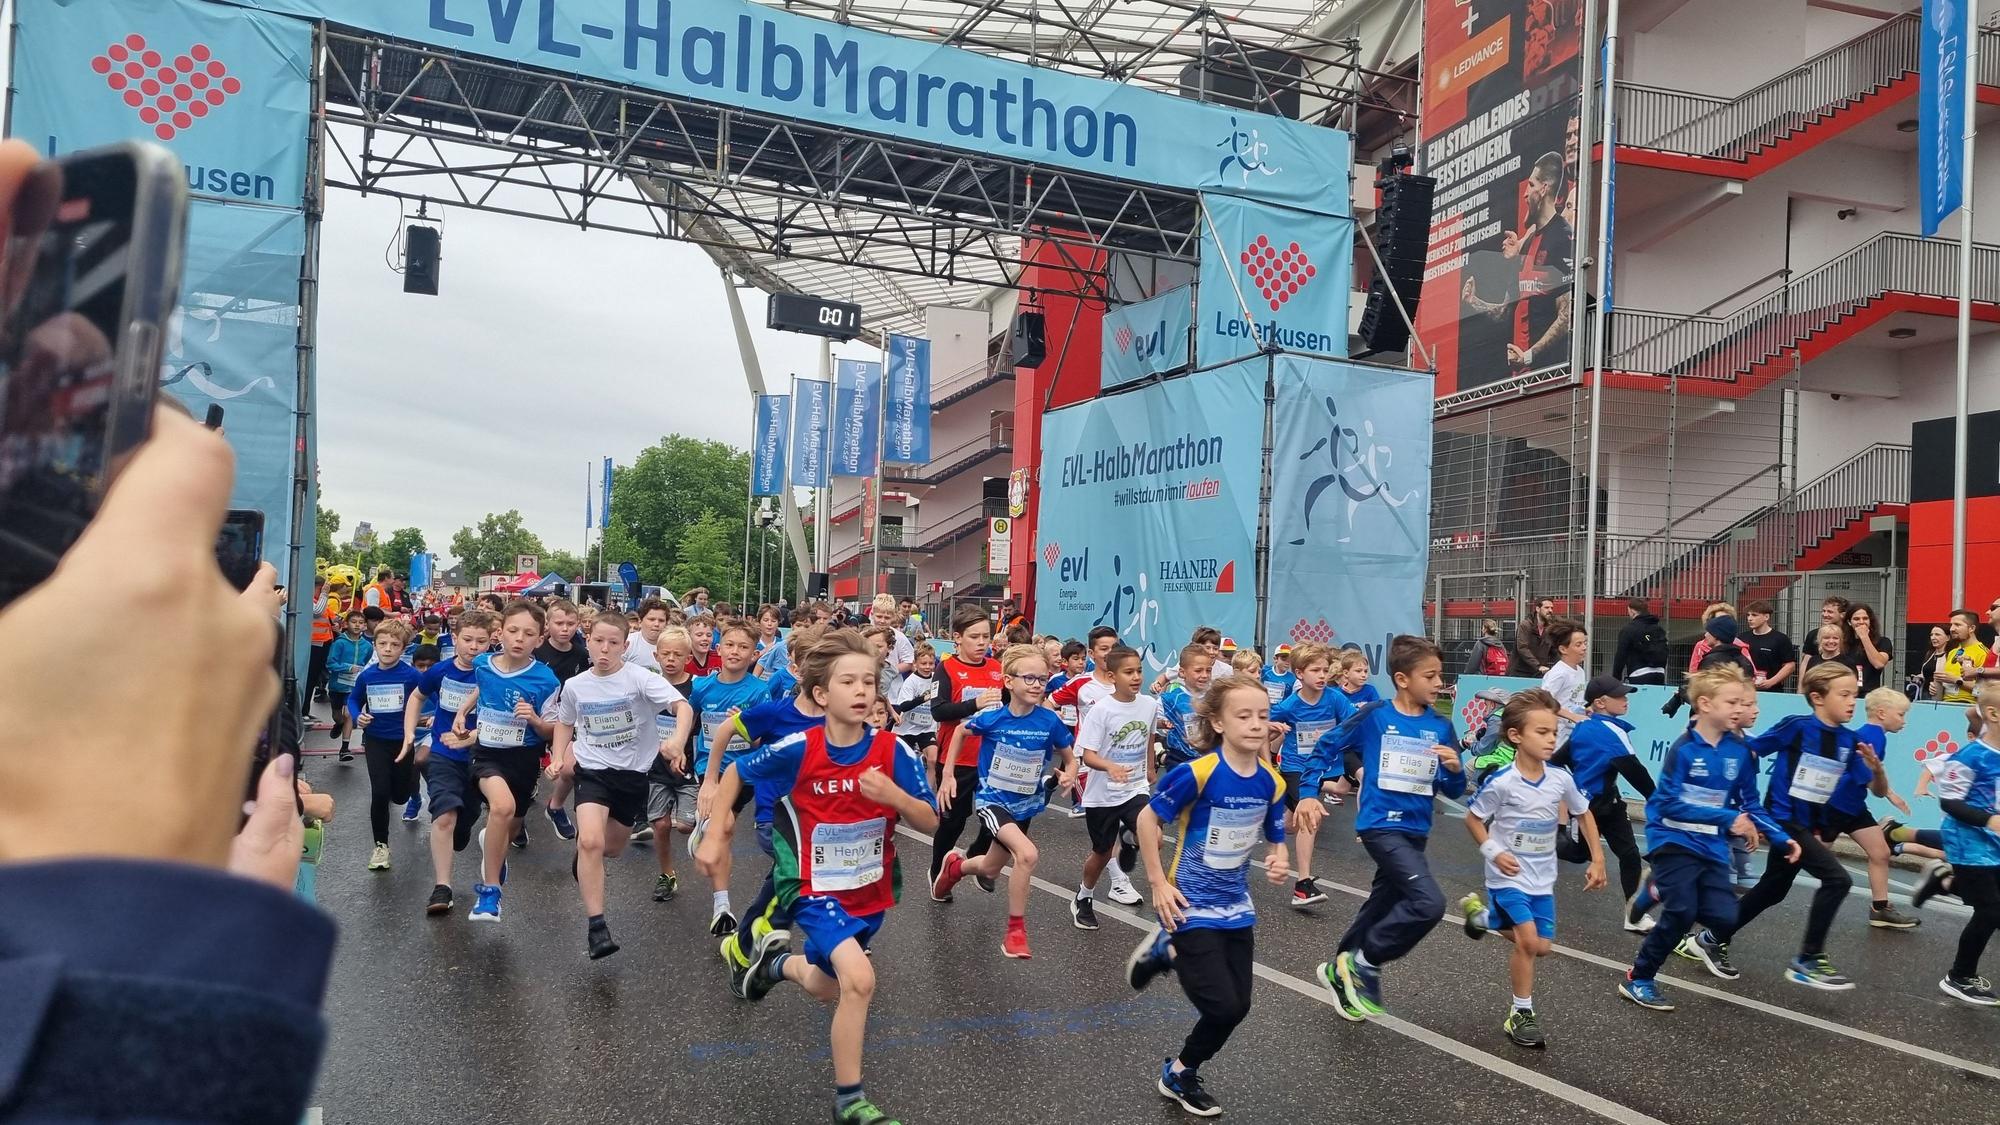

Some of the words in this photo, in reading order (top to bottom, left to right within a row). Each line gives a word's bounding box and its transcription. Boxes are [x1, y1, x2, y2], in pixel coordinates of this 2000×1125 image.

[1453, 36, 1504, 79] LEDVANCE
[1427, 136, 1445, 168] EIN
[1446, 89, 1531, 157] STRAHLENDES
[1432, 195, 1440, 210] ER
[1447, 189, 1489, 220] BELEUCHTUNG
[1466, 220, 1501, 246] DEUTSCHEN
[1134, 320, 1166, 362] evl
[1215, 311, 1332, 352] Leverkusen
[1061, 433, 1223, 488] EVL-HalbMarathon
[1060, 546, 1089, 582] evl
[1159, 558, 1219, 580] HAANER
[1059, 588, 1077, 600] Energie
[1163, 581, 1213, 594] FELSENQUELLE
[1066, 601, 1095, 611] Leverkusen
[485, 724, 513, 737] Gregor
[594, 714, 620, 725] Eliano
[1005, 762, 1031, 773] Jonas
[1399, 755, 1423, 767] Elias
